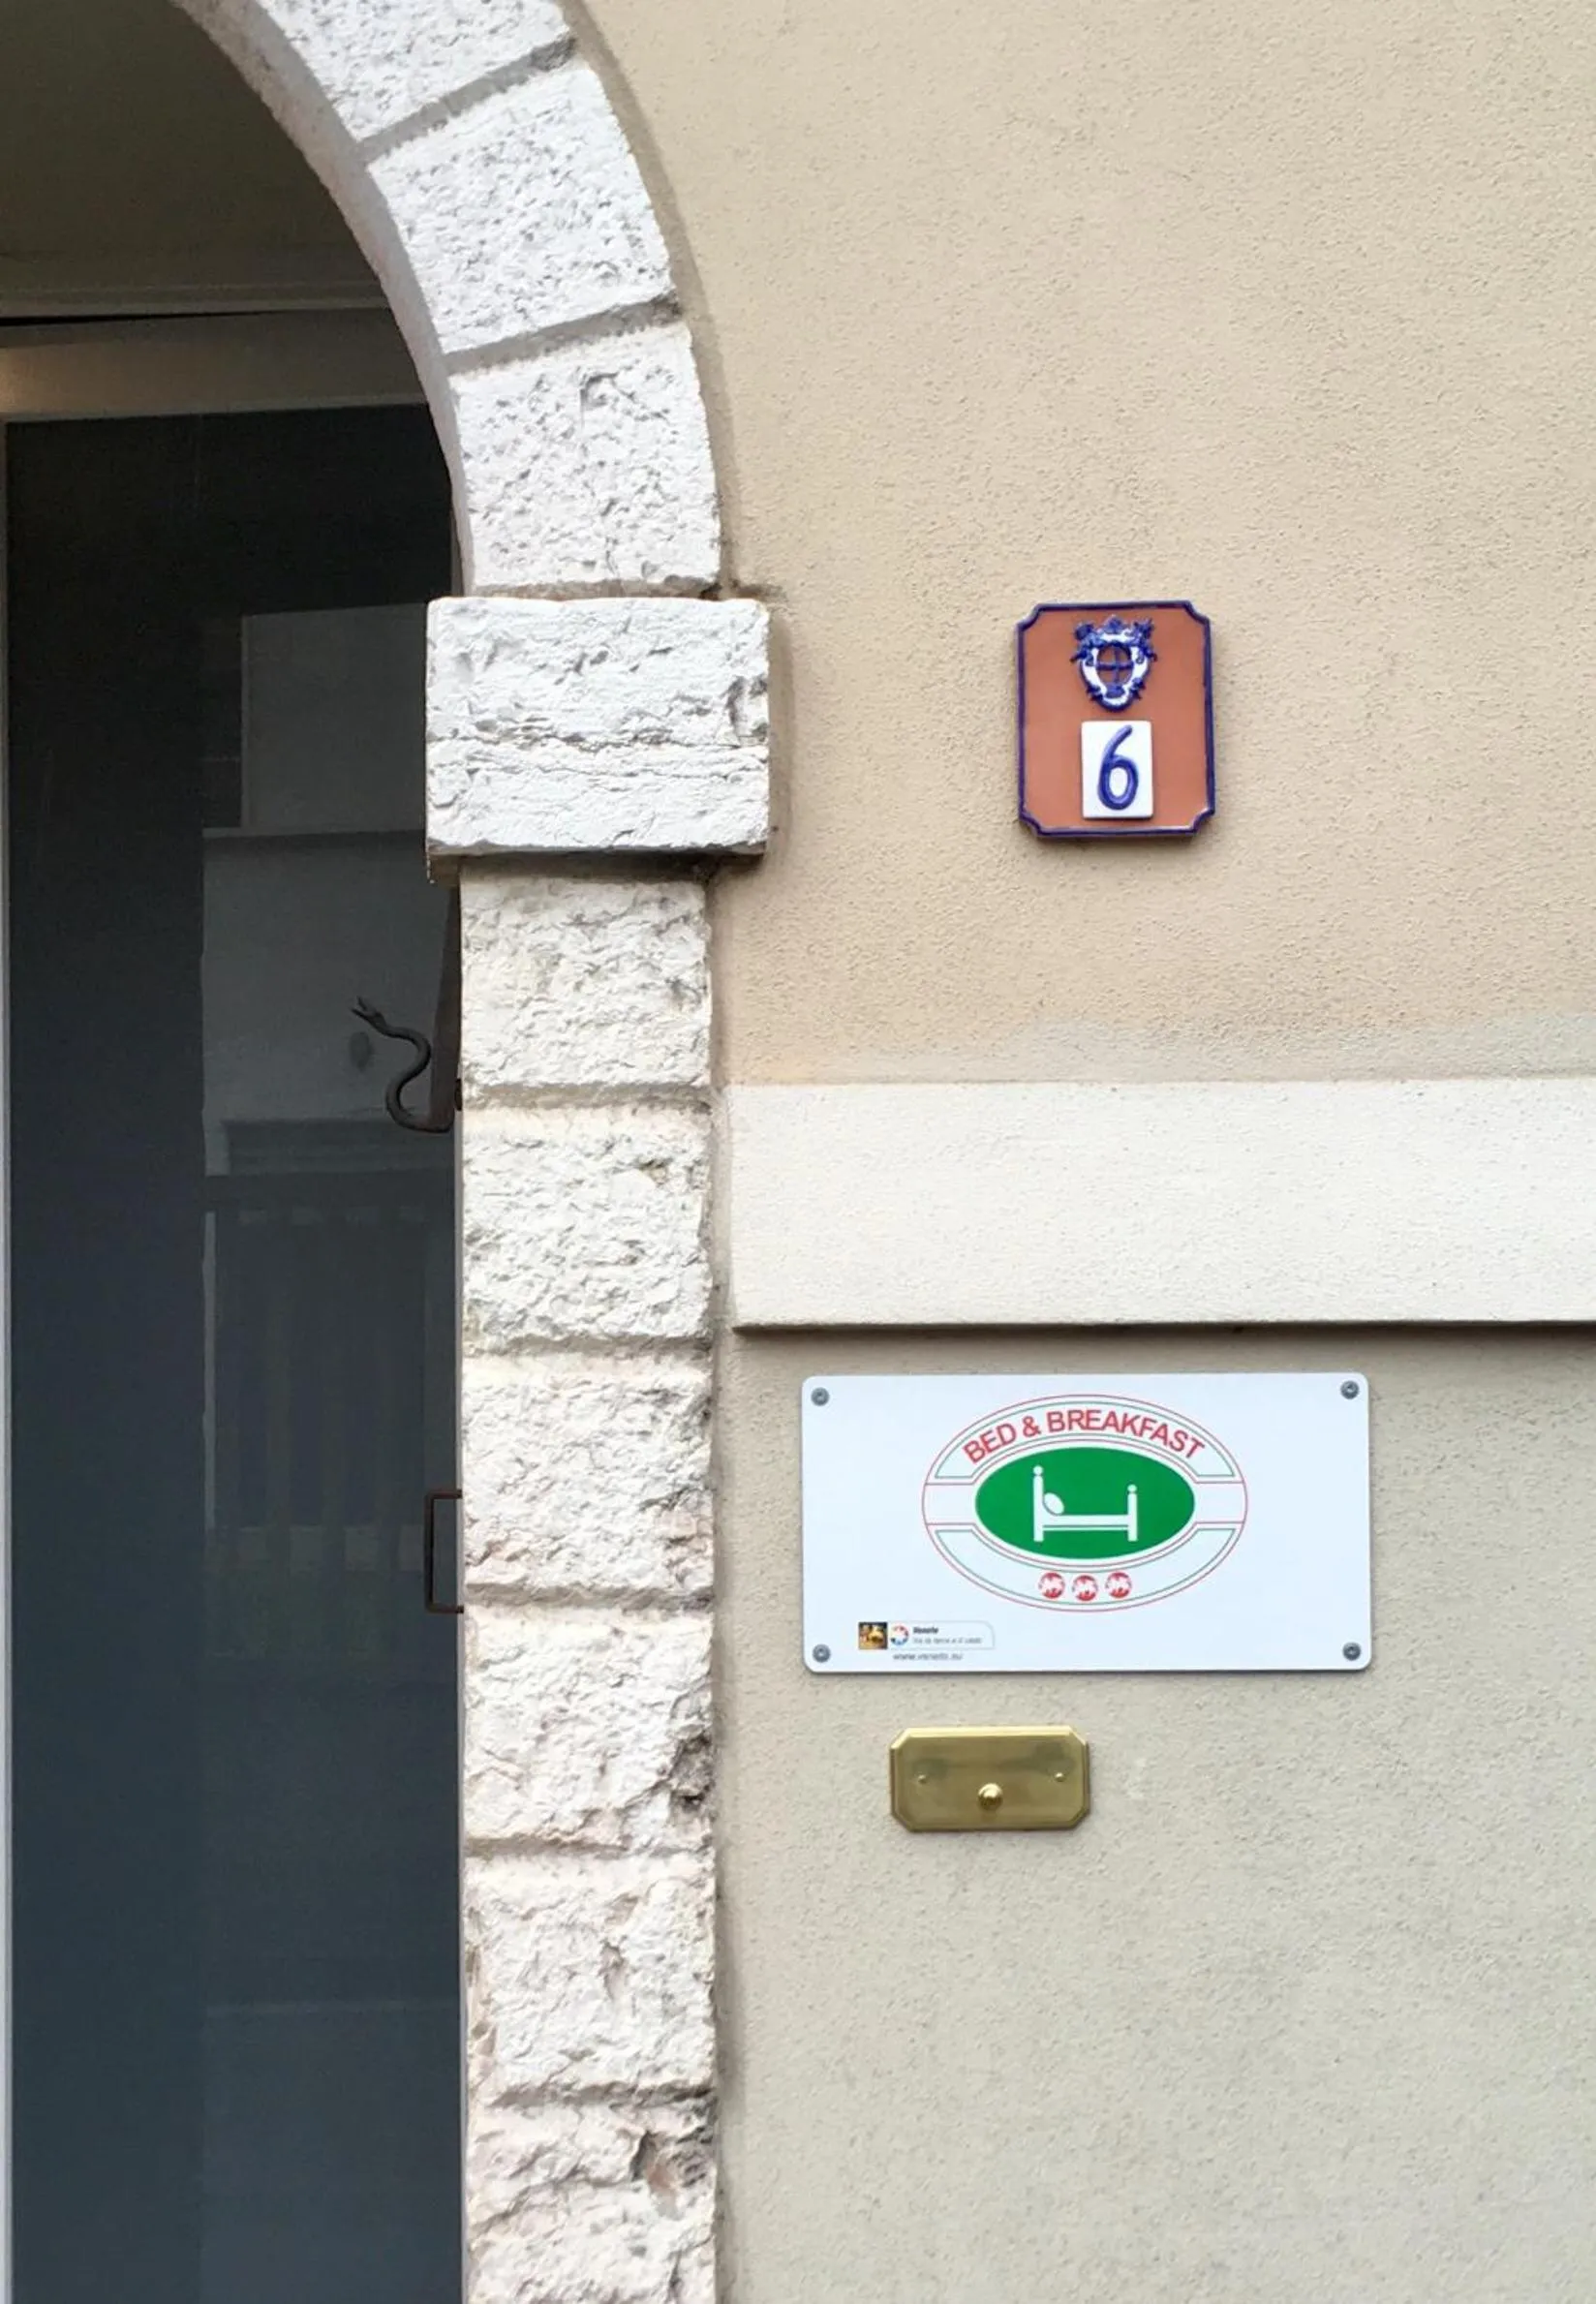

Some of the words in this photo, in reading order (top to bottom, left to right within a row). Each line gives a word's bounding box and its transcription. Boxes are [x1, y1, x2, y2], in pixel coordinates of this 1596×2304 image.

[1097, 724, 1139, 811] 6
[963, 1423, 1017, 1463] BED
[1022, 1416, 1041, 1438] &
[1047, 1409, 1205, 1459] BREAKFAST
